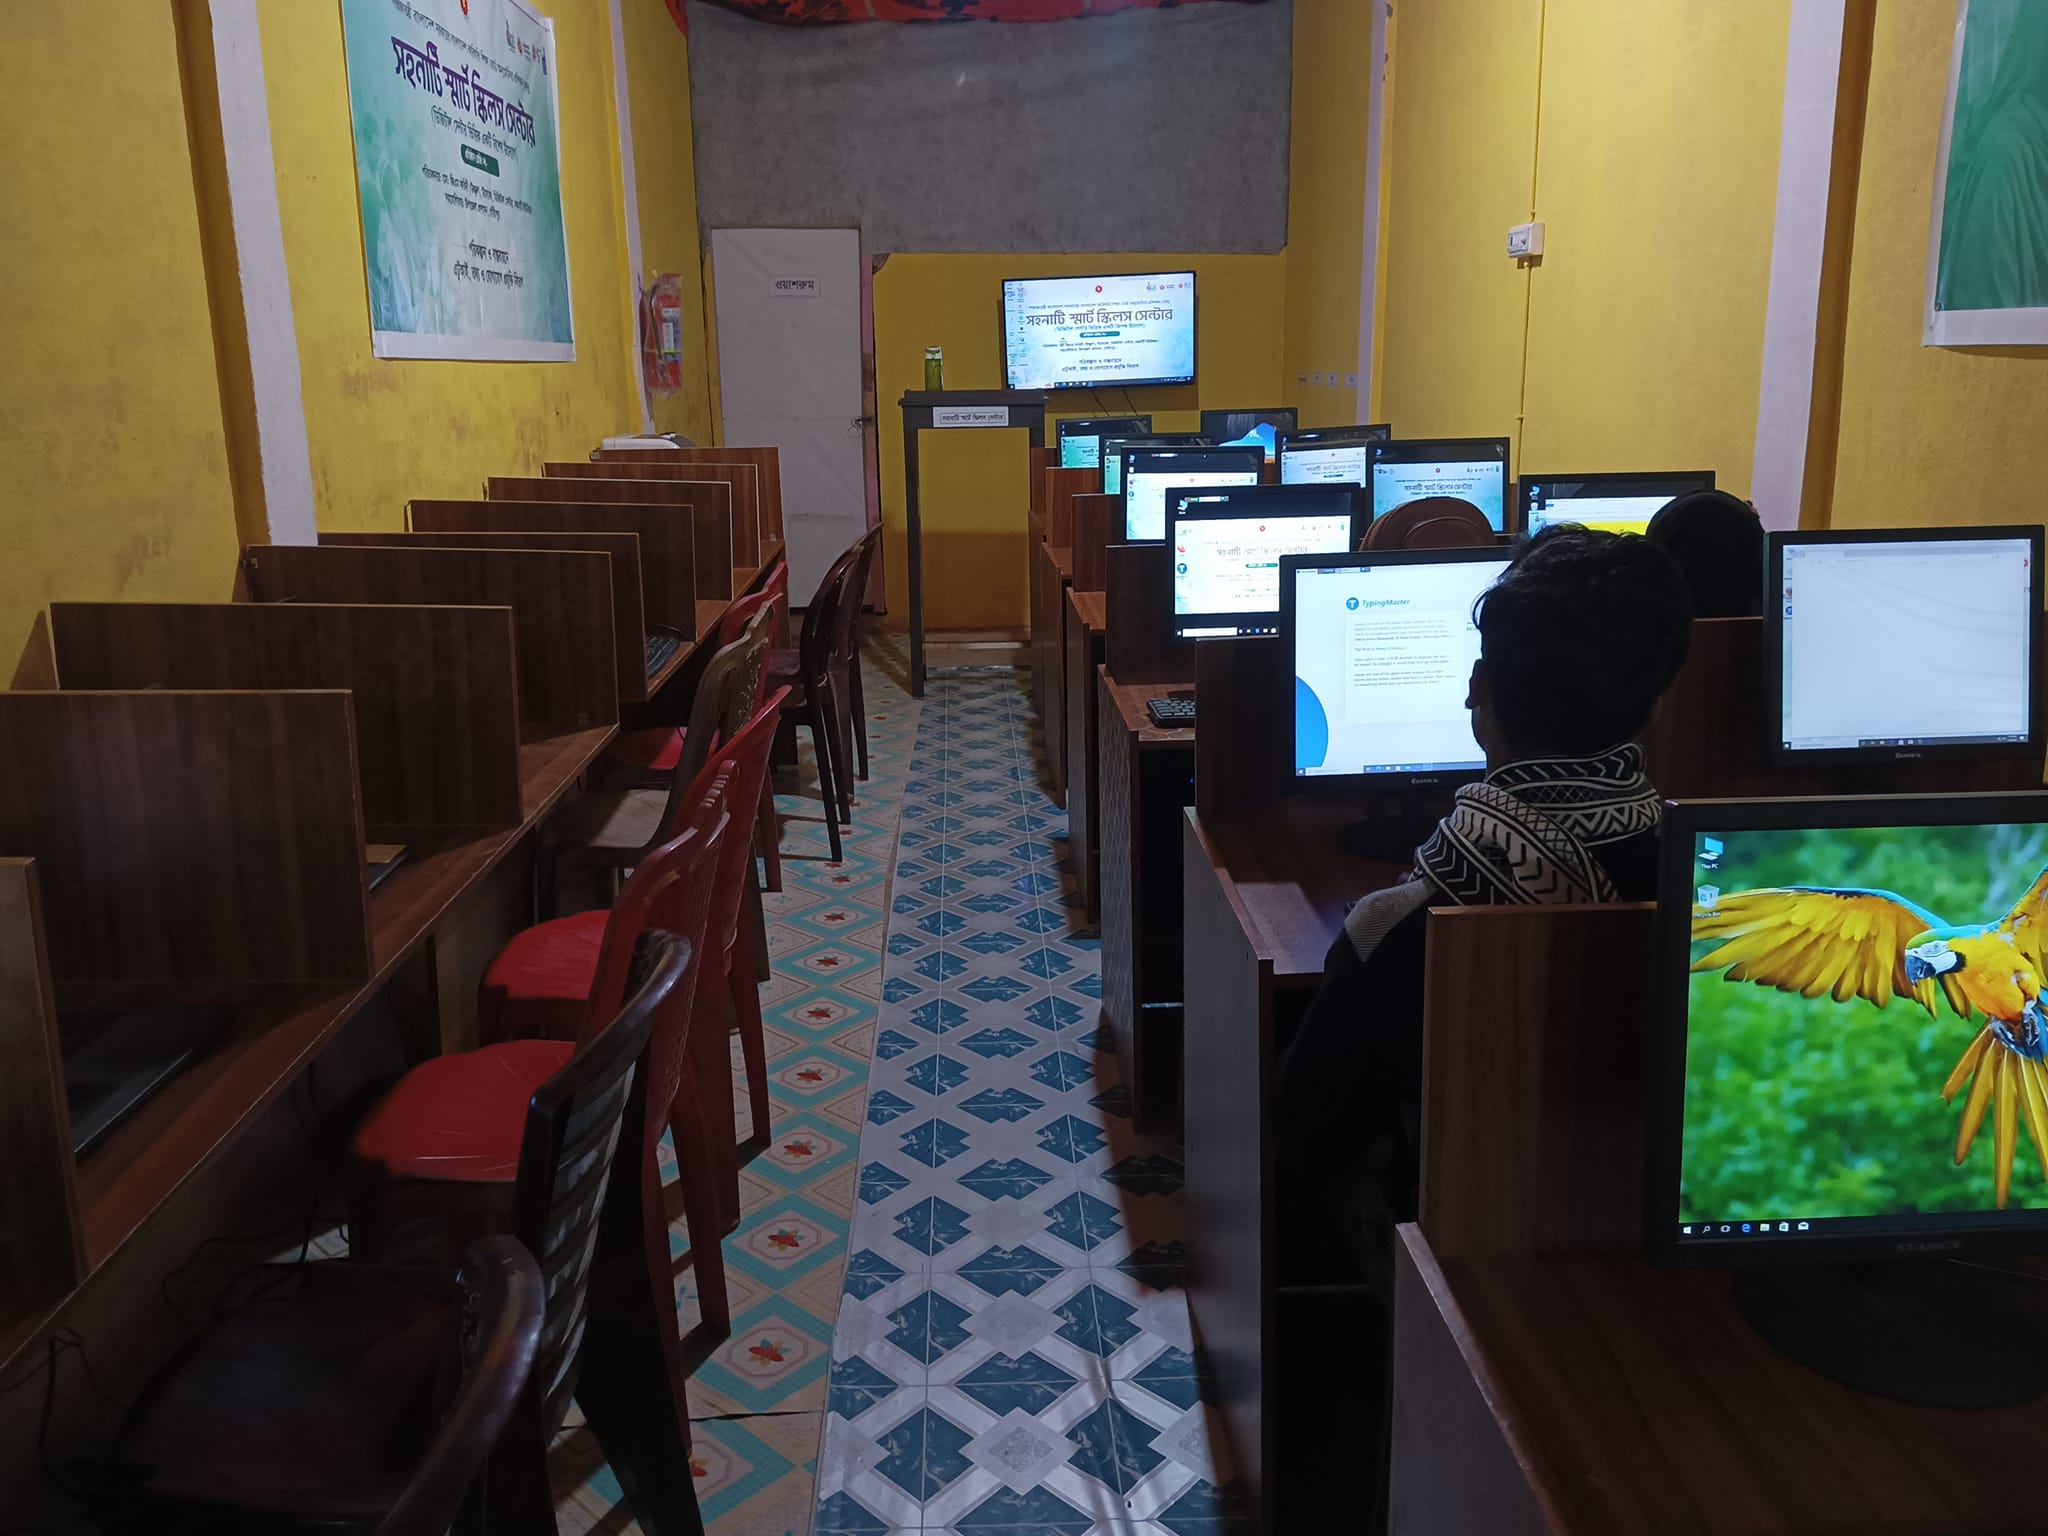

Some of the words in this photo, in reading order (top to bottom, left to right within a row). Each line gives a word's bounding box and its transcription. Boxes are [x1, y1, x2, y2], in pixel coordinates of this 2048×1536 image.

[391, 36, 443, 97] সহনাটি
[442, 64, 471, 112] স্মার্ট
[471, 69, 505, 131] স্কিলস
[506, 100, 536, 149] সেন্টার
[775, 280, 815, 290] ওয়াশরুম
[1026, 309, 1066, 327] সহনাটি
[1068, 309, 1094, 325] স্মার্ট
[1096, 308, 1132, 325] স্কিলস
[1135, 306, 1173, 321] সেন্টার
[1362, 599, 1410, 608] TypingMaster
